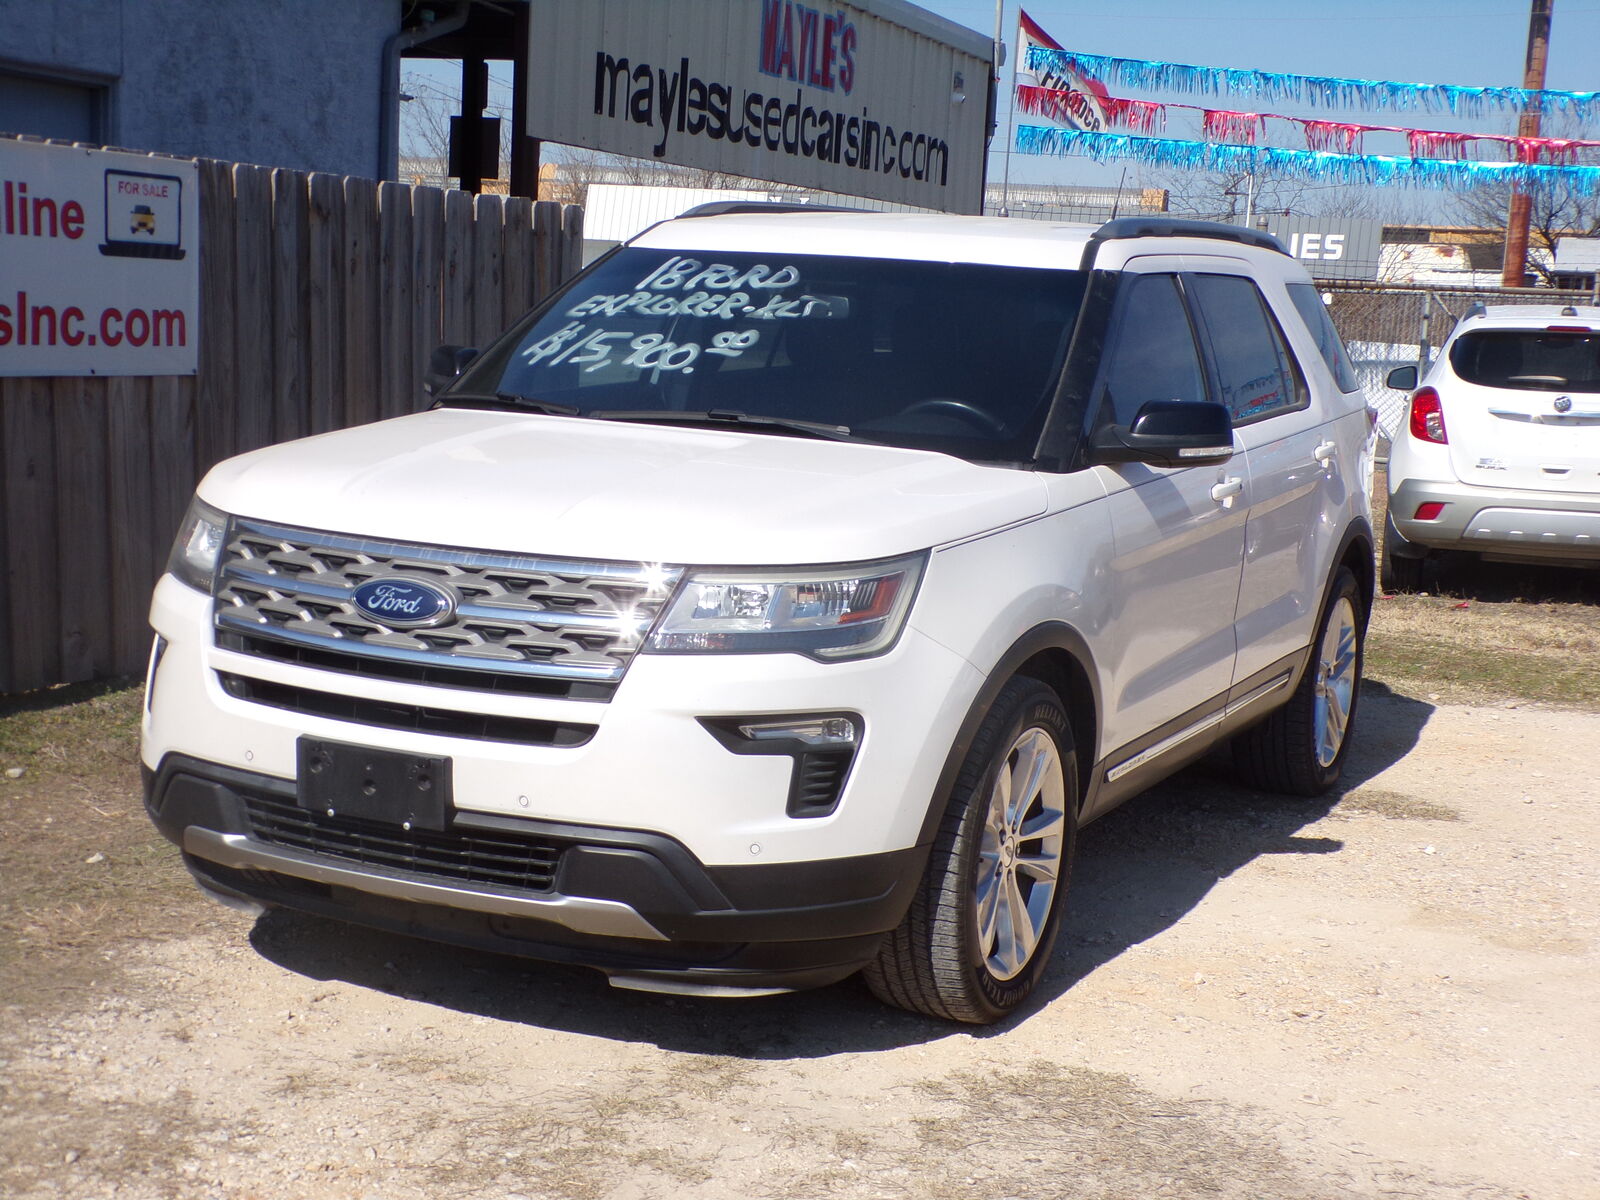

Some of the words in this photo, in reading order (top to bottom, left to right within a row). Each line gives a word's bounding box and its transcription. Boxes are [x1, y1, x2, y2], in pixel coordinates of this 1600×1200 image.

[759, 0, 857, 96] MAYLE'S
[594, 52, 948, 186] maylesusedcarsinc.com
[0, 180, 84, 239] line
[118, 181, 139, 194] FOR
[142, 183, 169, 198] SALE
[635, 256, 701, 290] 18
[682, 263, 800, 290] FORD
[368, 584, 423, 614] Ford
